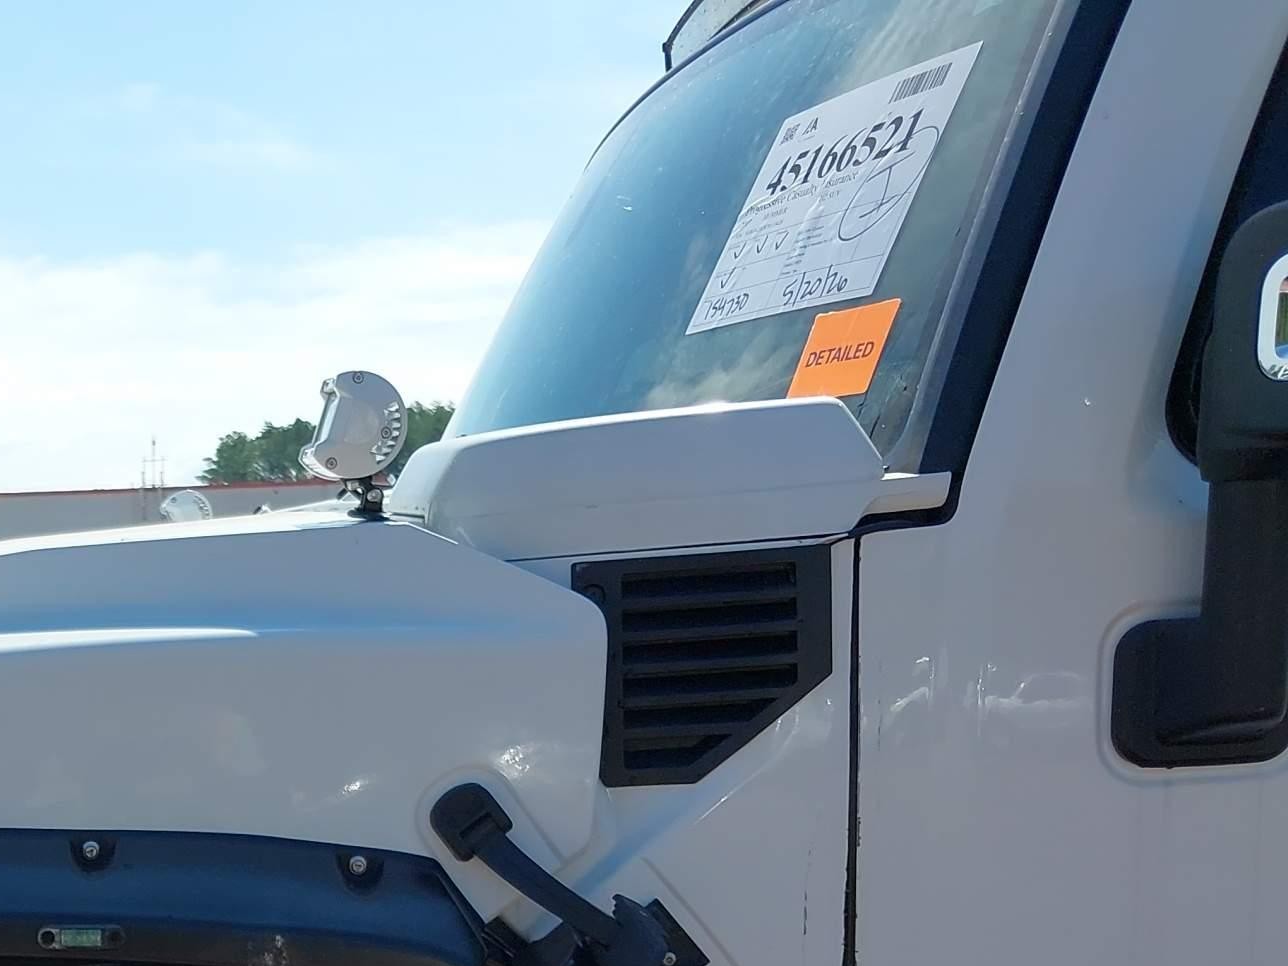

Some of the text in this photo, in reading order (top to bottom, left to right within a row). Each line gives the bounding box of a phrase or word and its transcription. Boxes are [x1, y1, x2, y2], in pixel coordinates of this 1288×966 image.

[766, 108, 924, 196] 45166521
[782, 264, 848, 307] 5/20/26
[805, 341, 875, 368] DETAILED
